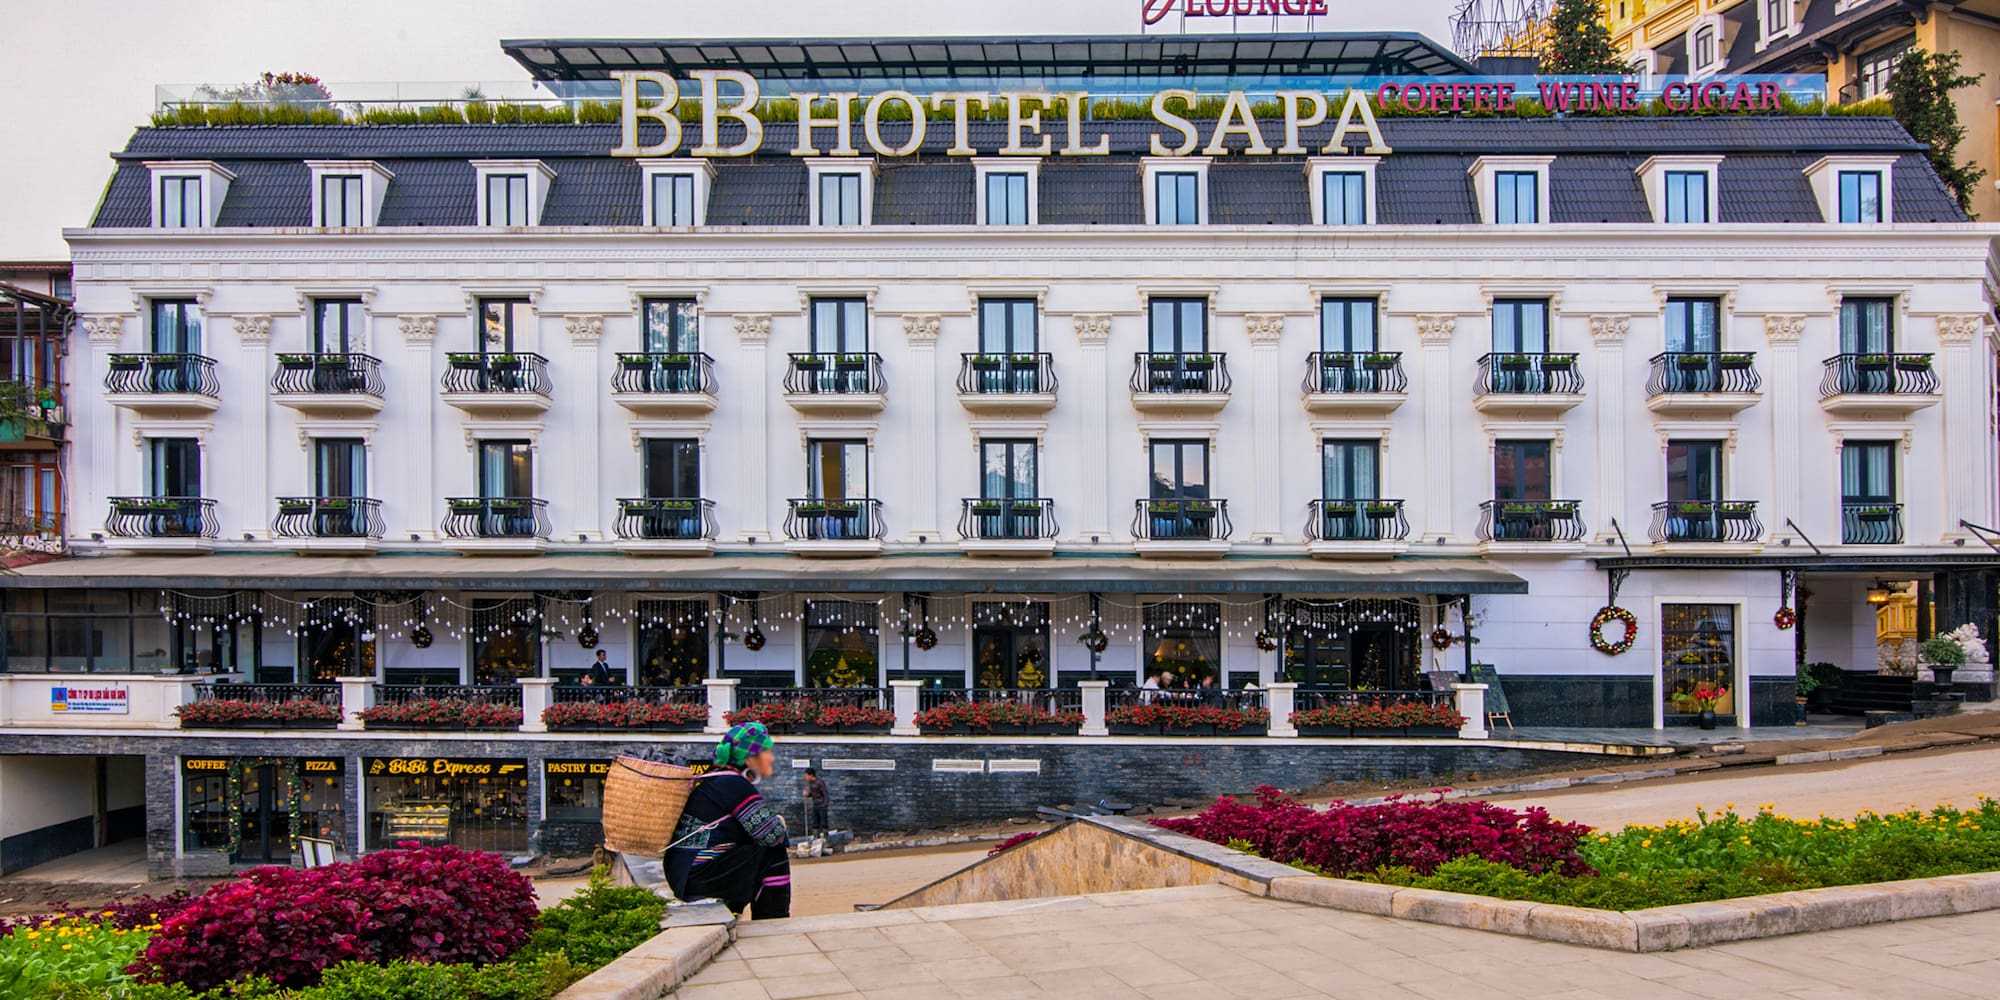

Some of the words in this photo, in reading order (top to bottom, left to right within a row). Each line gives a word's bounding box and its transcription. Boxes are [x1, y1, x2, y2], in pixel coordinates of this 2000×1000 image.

[1378, 81, 1516, 112] COFFEE
[1536, 81, 1640, 112] WINE
[1664, 81, 1783, 112] CIGAR
[610, 69, 764, 157] BB
[789, 89, 1109, 157] HOTEL
[1151, 88, 1392, 157] SAPA
[187, 760, 226, 770] COFFEE
[305, 761, 336, 771] PIZZA
[388, 758, 428, 774] BiBi
[433, 759, 491, 777] Express
[547, 763, 586, 773] PASTRY
[589, 763, 610, 773] ICE-
